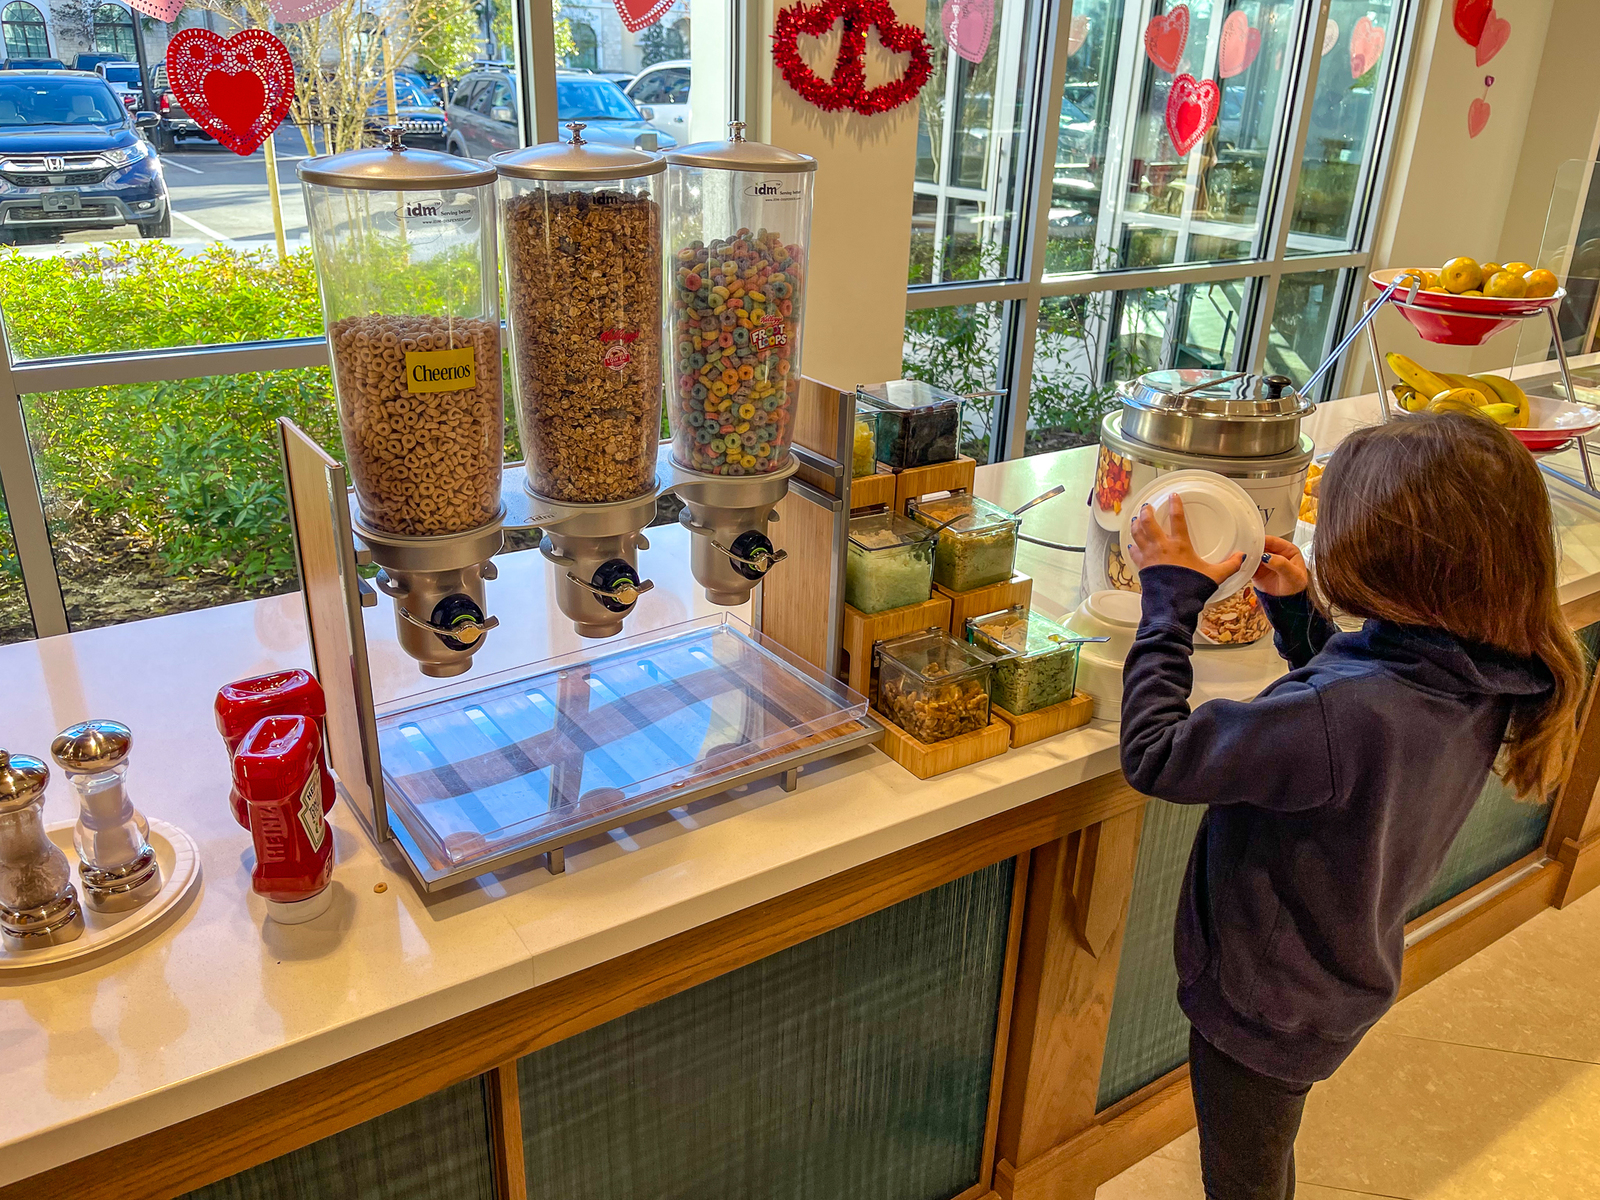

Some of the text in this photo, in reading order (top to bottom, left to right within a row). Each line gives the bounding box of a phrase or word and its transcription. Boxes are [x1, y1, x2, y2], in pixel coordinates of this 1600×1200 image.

[752, 324, 785, 343] FROOT
[758, 334, 788, 349] LOOPS
[412, 364, 471, 382] Cheerios
